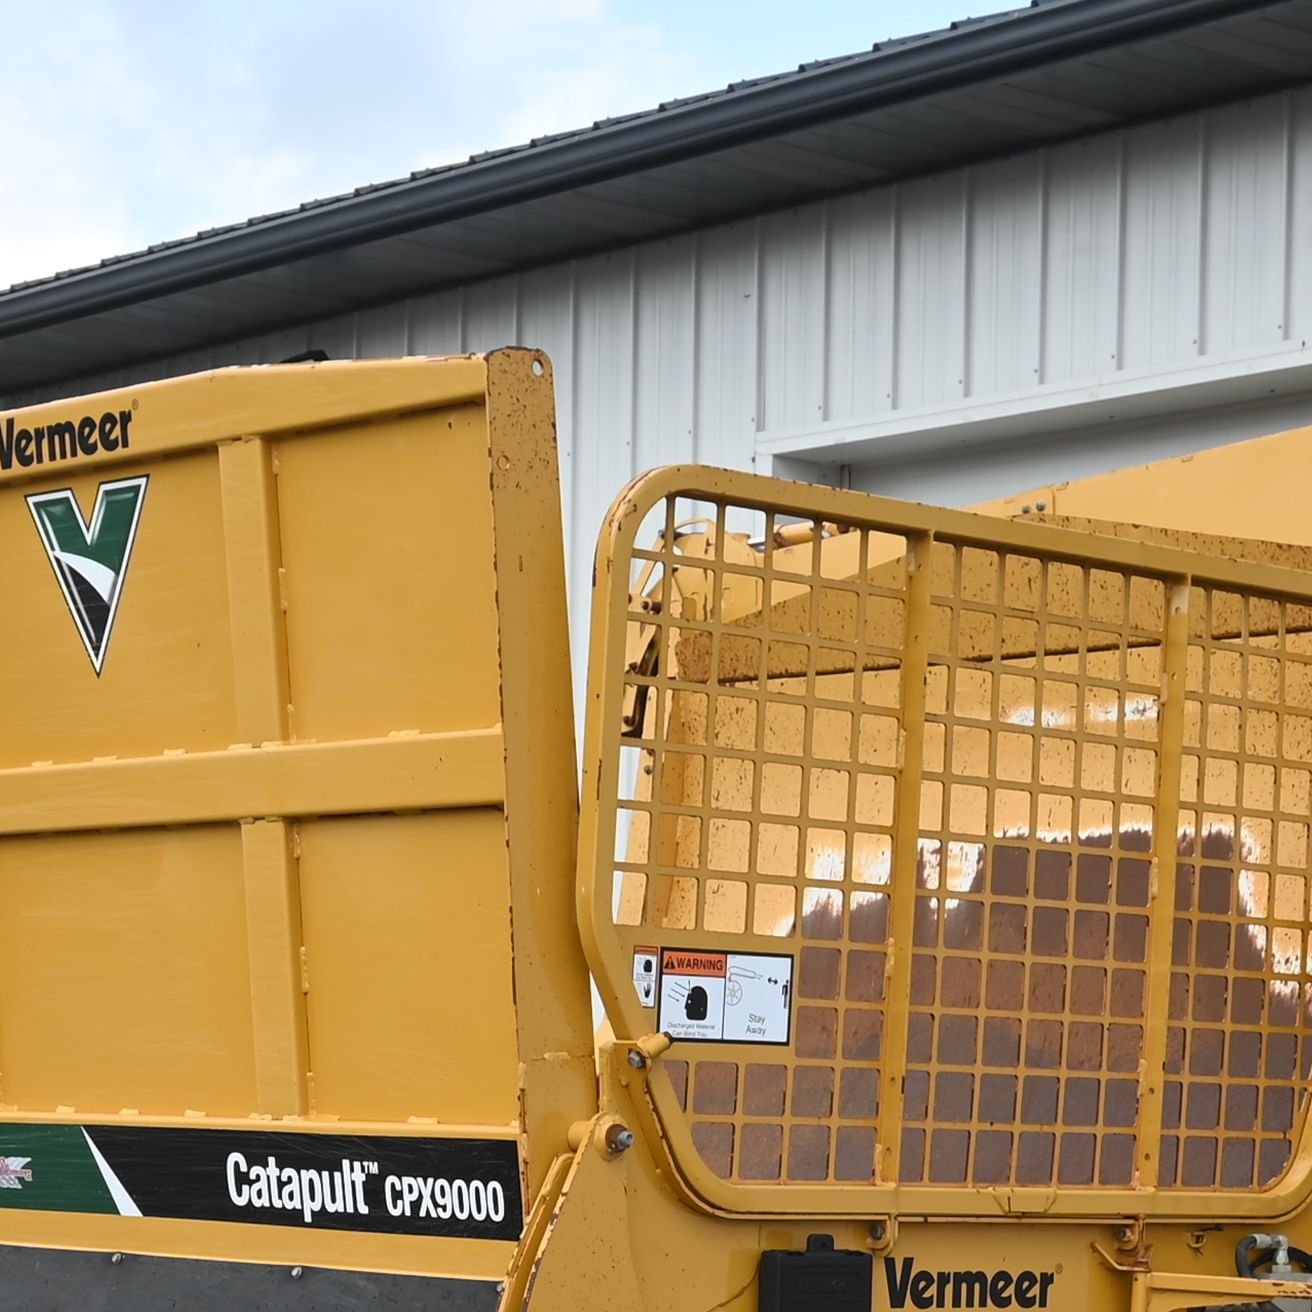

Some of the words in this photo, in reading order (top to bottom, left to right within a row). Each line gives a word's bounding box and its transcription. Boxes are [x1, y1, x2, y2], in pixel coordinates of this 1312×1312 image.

[676, 958, 724, 972] WARNING
[748, 1013, 766, 1026] Stay
[745, 1025, 767, 1037] Away
[384, 1175, 505, 1222] CPX9000
